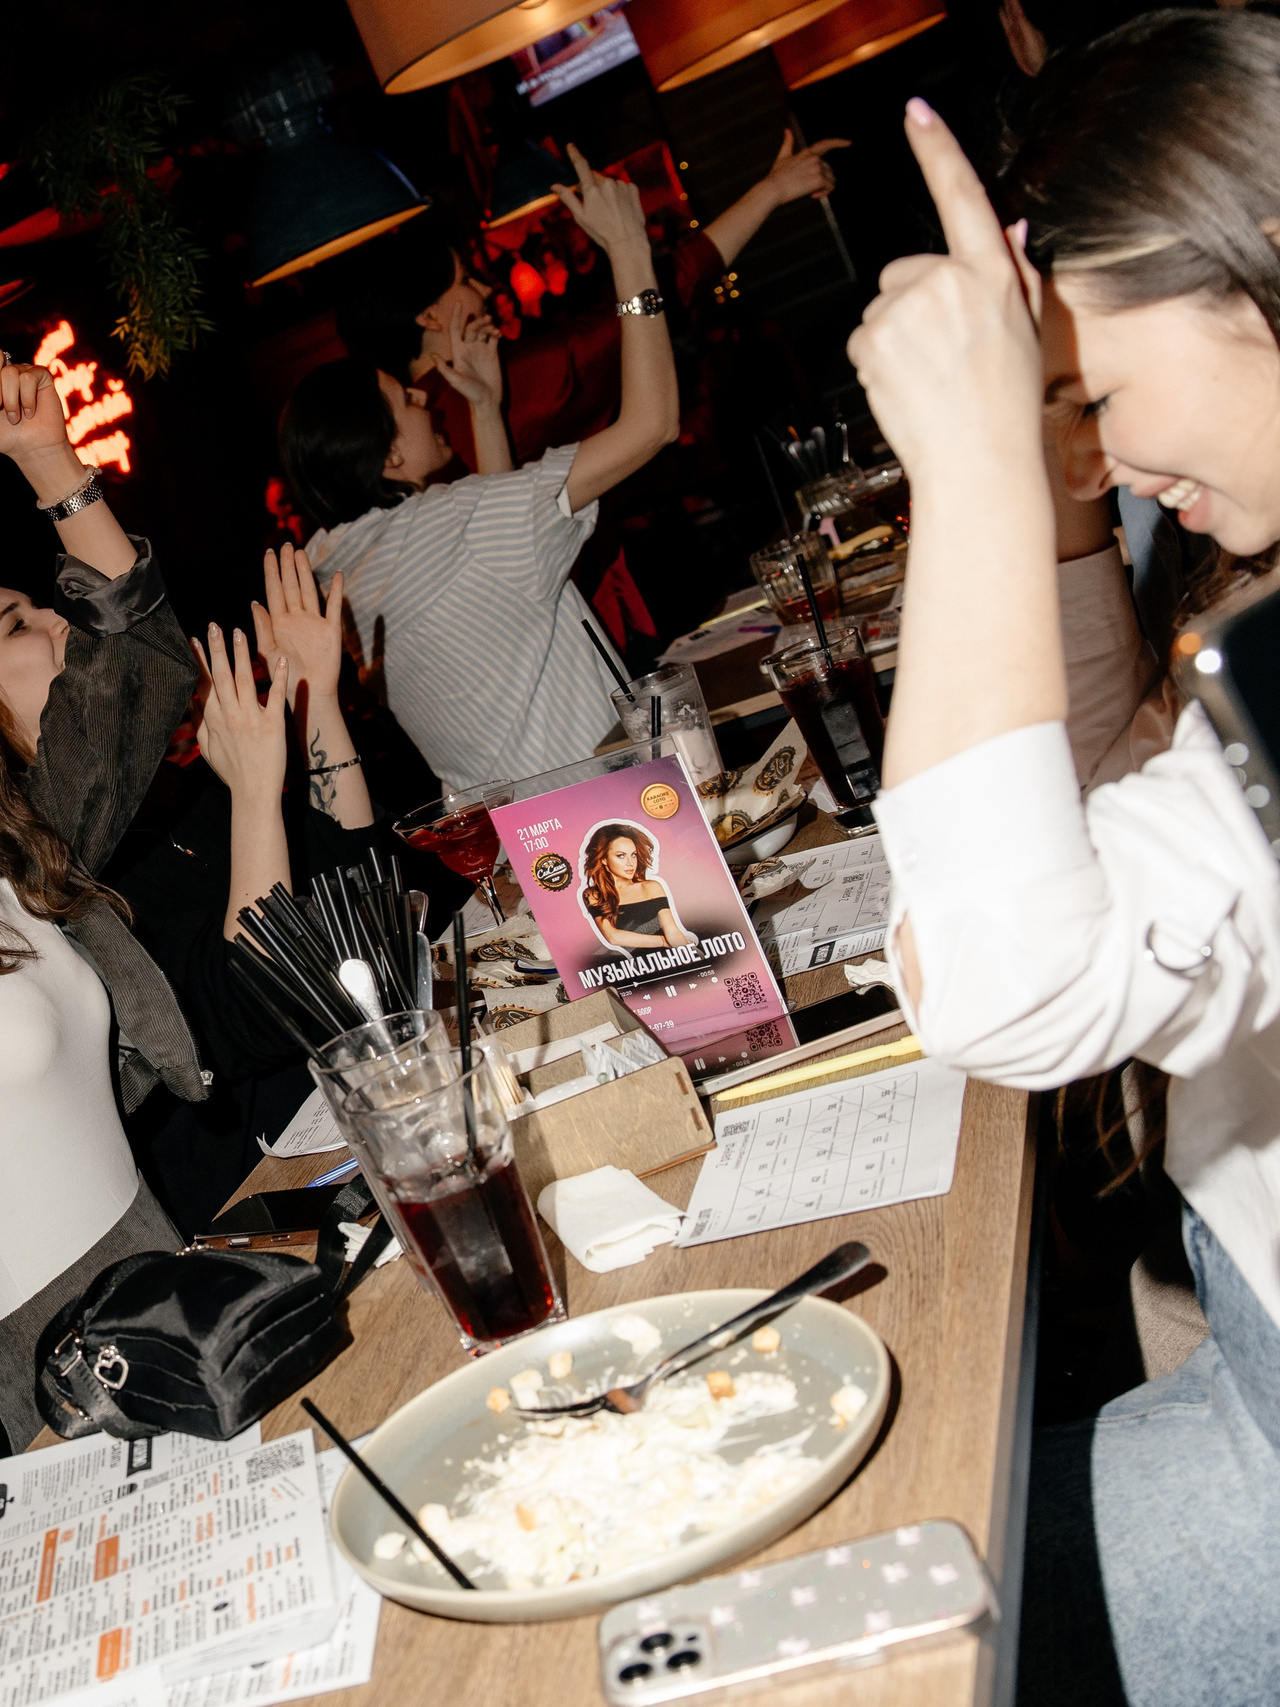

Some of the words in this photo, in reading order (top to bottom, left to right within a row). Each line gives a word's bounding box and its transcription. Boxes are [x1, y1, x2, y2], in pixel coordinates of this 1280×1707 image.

[646, 791, 670, 801] KARAOKE
[517, 825, 531, 842] 21
[530, 817, 563, 838] МАРТА
[523, 836, 549, 853] 17:00
[578, 941, 701, 990] МУЗЫКАЛЬНОЕ
[700, 931, 747, 961] ЛОТО
